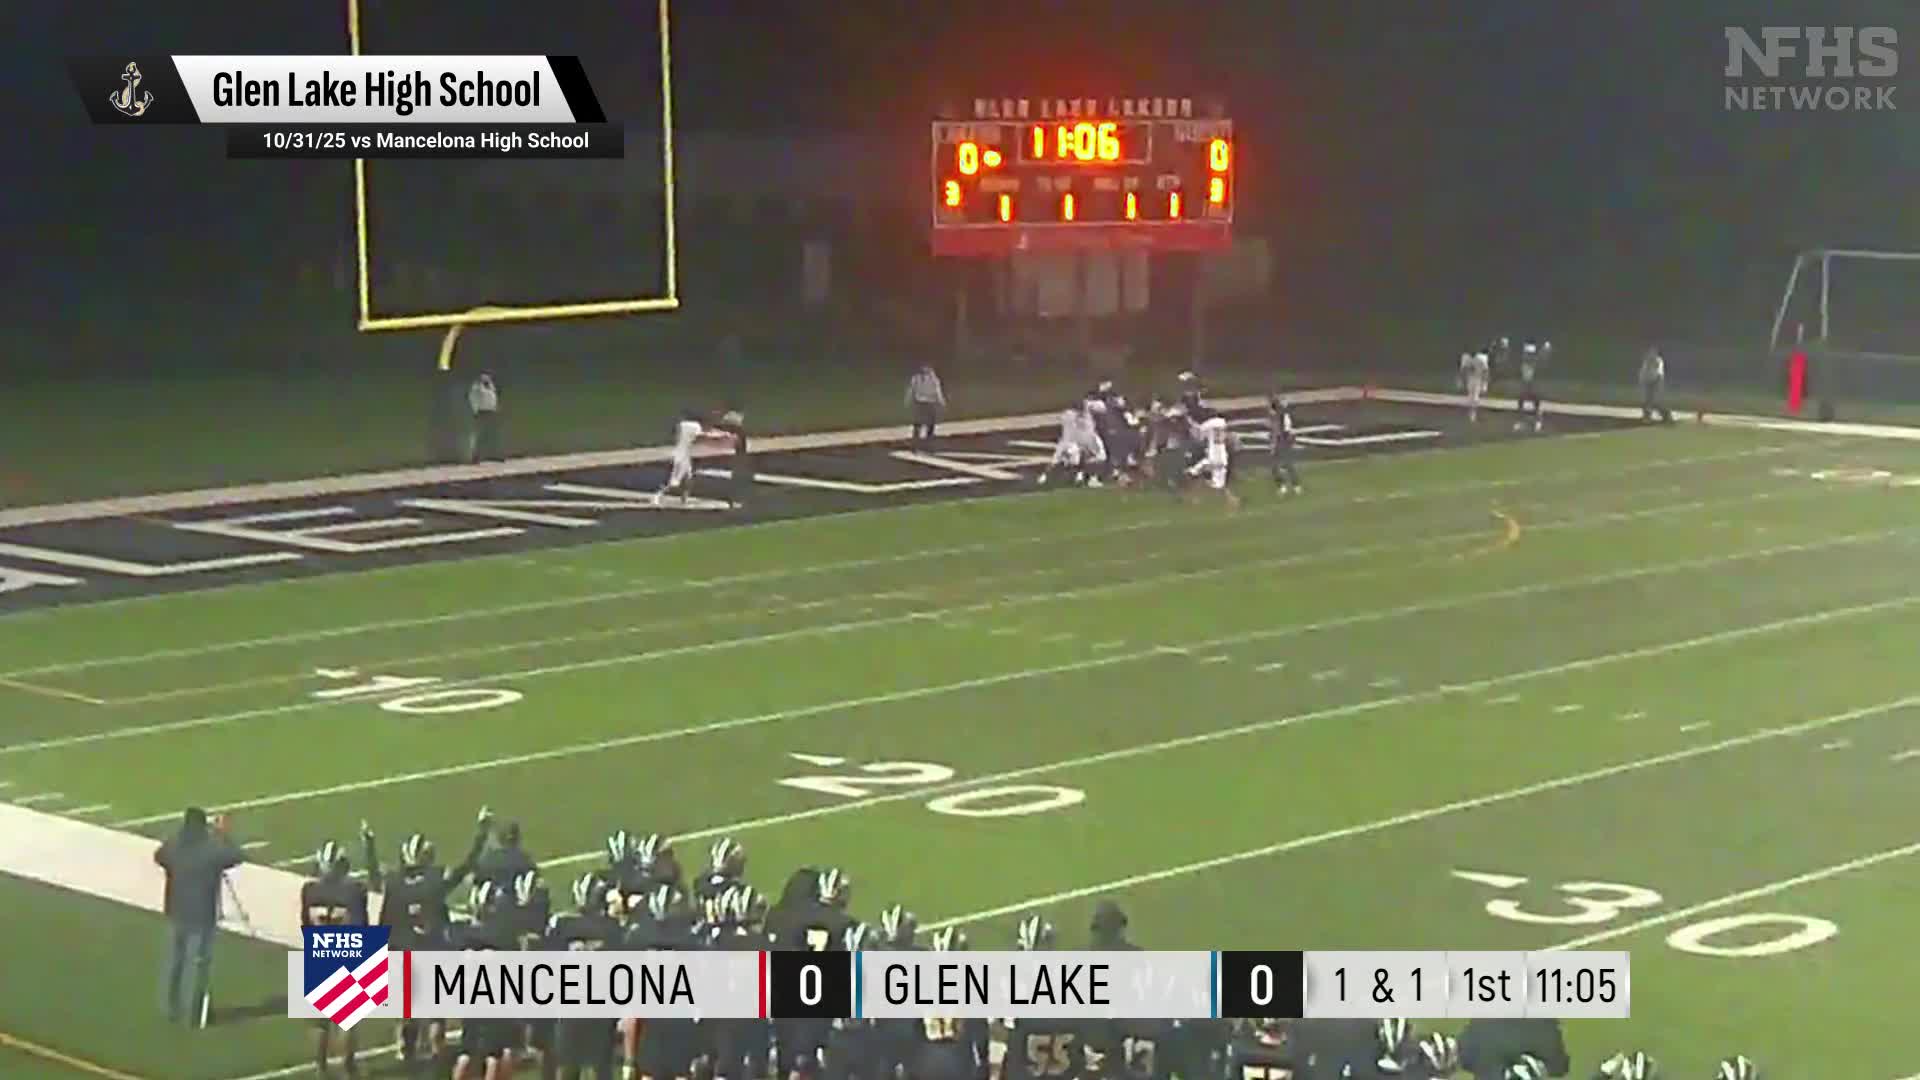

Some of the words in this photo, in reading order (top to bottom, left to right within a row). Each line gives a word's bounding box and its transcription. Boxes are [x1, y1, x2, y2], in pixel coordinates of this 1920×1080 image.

[1033, 121, 1120, 161] 11:06
[1210, 138, 1229, 172] 0
[959, 142, 979, 175] 0
[945, 180, 961, 206] 3
[1064, 194, 1074, 221] 1
[1126, 193, 1137, 220] 1
[1169, 192, 1180, 218] 1
[1000, 195, 1011, 222] 1
[775, 761, 1087, 817] 20
[1485, 881, 1839, 957] 30
